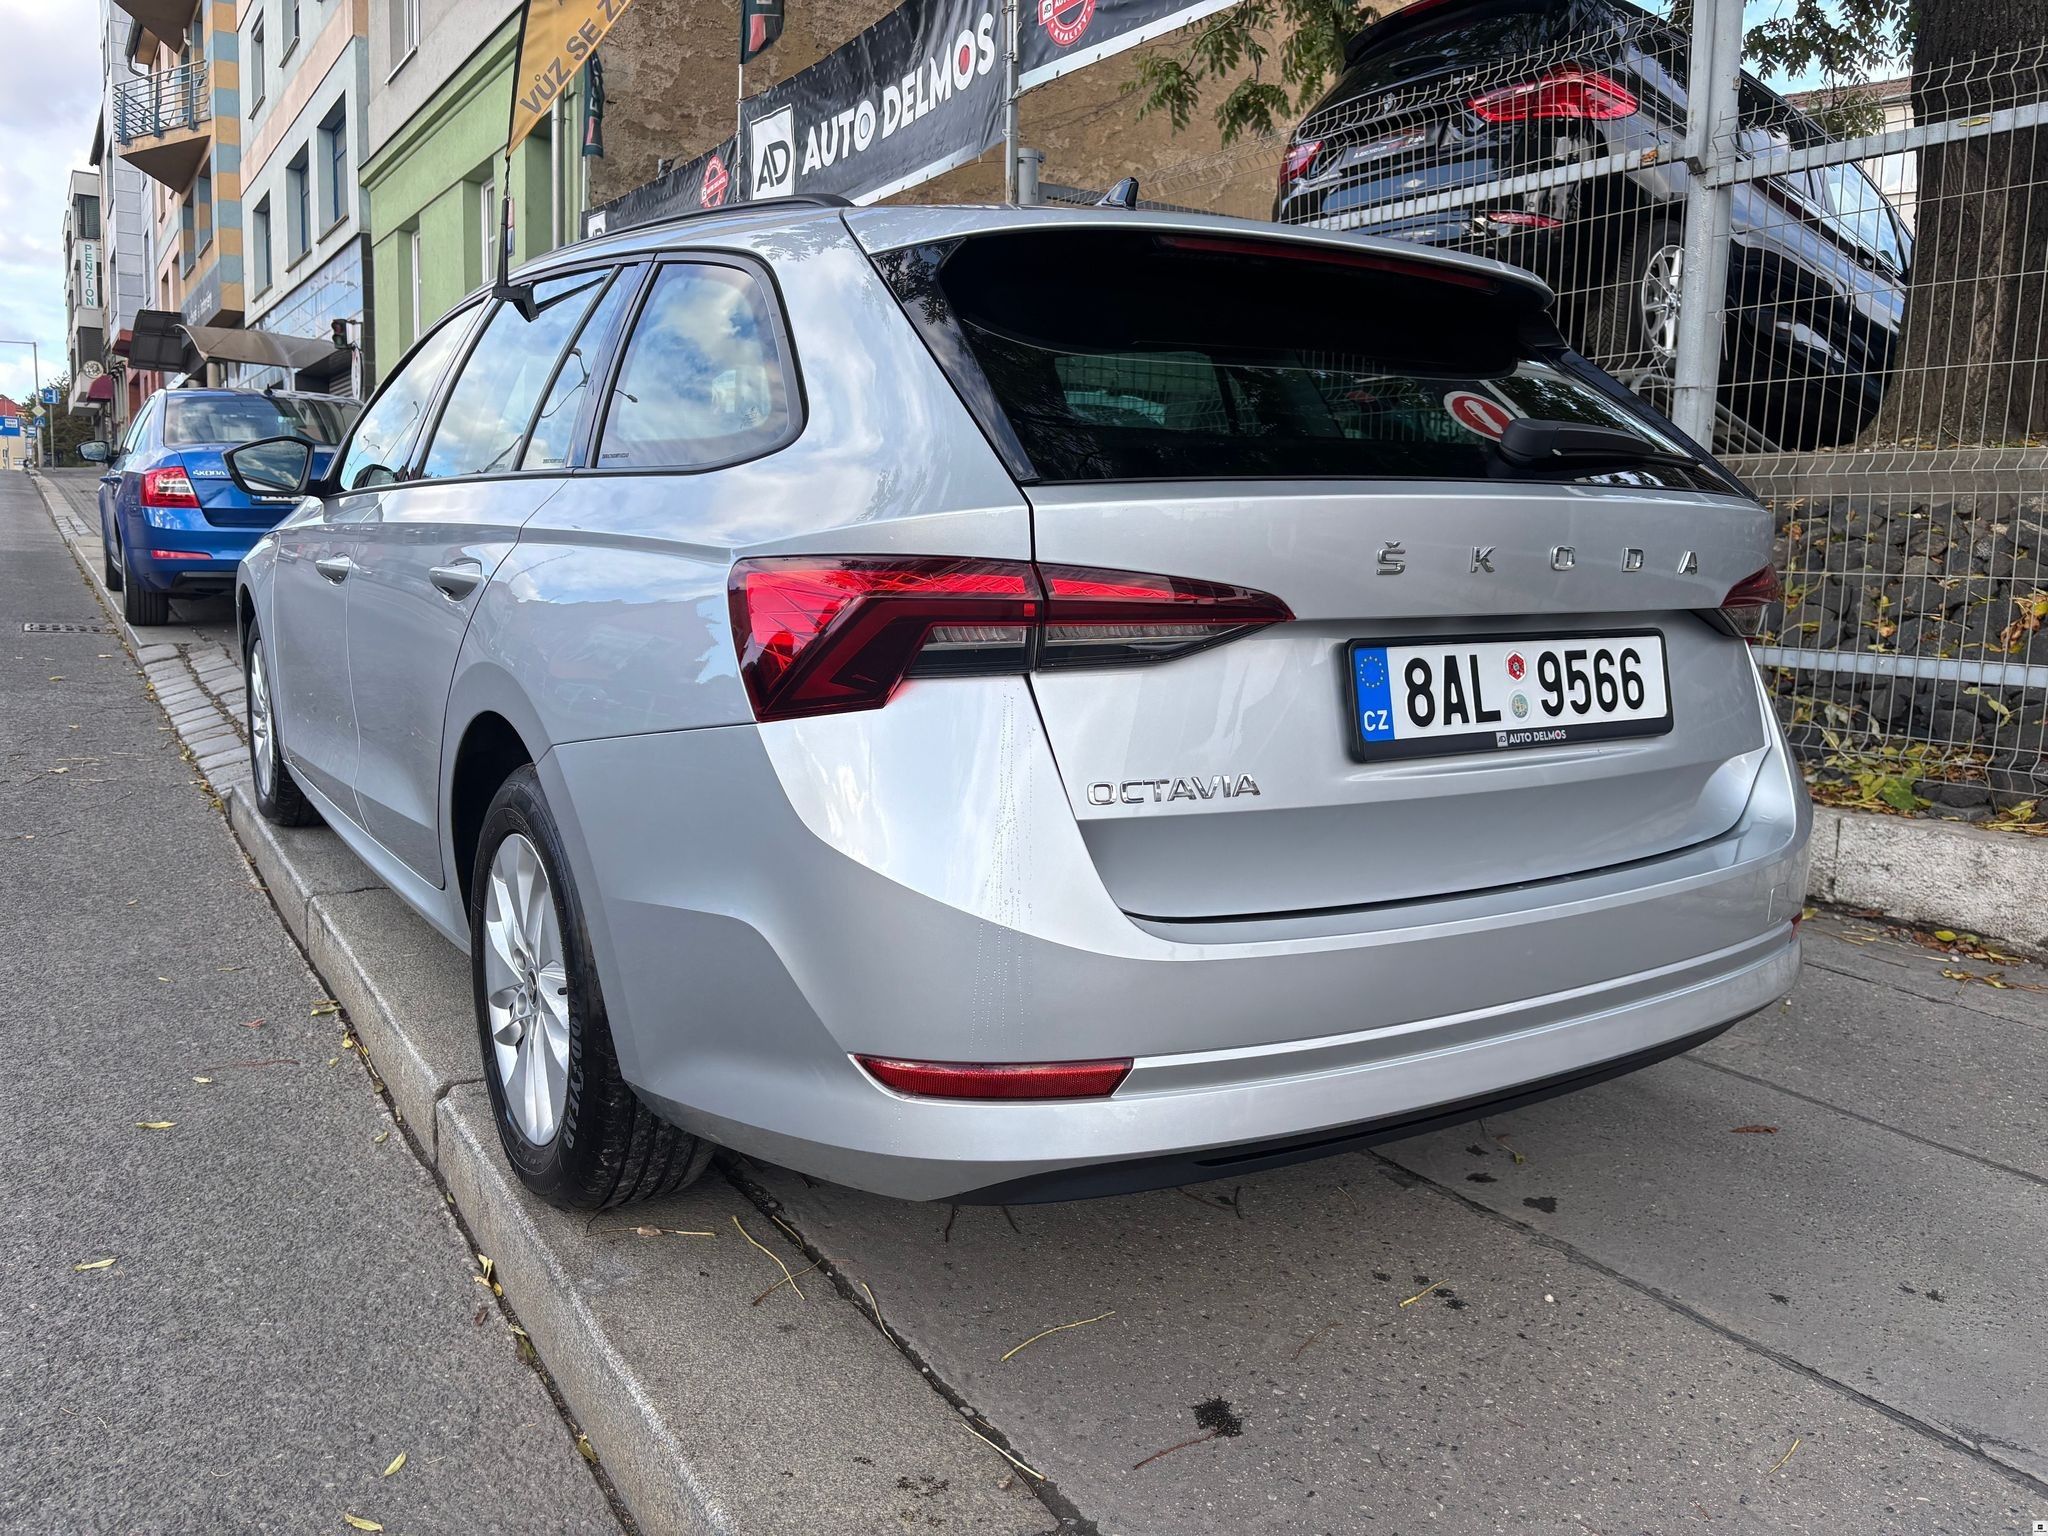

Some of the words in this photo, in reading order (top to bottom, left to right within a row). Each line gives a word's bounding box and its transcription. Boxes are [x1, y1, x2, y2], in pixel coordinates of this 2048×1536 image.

[520, 57, 572, 114] VŮZ
[566, 18, 603, 61] SE
[756, 140, 791, 192] AD
[801, 100, 876, 175] AUTO
[882, 12, 995, 139] DELMOS
[84, 244, 95, 306] PENZION
[1376, 540, 1698, 576] ŠKODA
[1404, 654, 1501, 728] 8AL
[1536, 647, 1645, 717] 9566
[1363, 709, 1389, 731] CZ
[1509, 732, 1532, 744] AUTO
[1533, 729, 1567, 741] DELMOS
[1087, 772, 1261, 806] OCTAVIA
